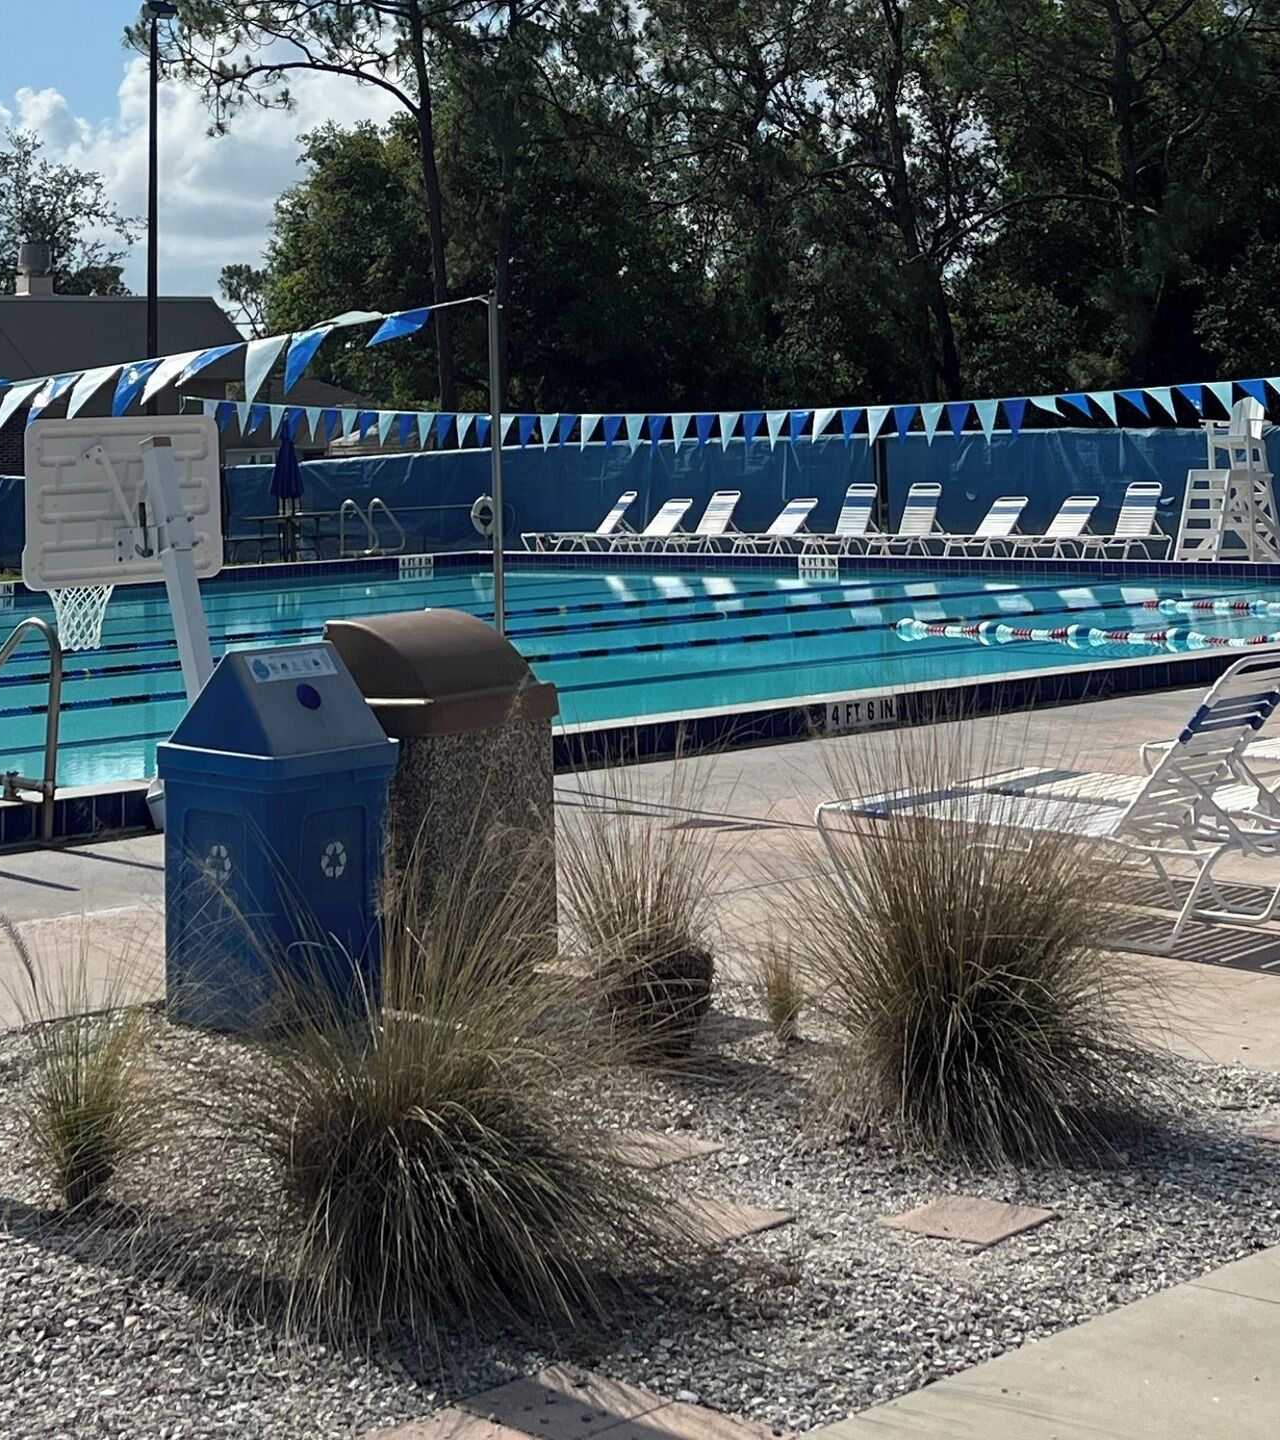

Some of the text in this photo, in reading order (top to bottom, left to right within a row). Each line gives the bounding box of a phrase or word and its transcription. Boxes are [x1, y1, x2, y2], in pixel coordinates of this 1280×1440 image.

[831, 705, 839, 725] 4
[845, 703, 861, 724] FT.
[880, 699, 896, 719] IN.
